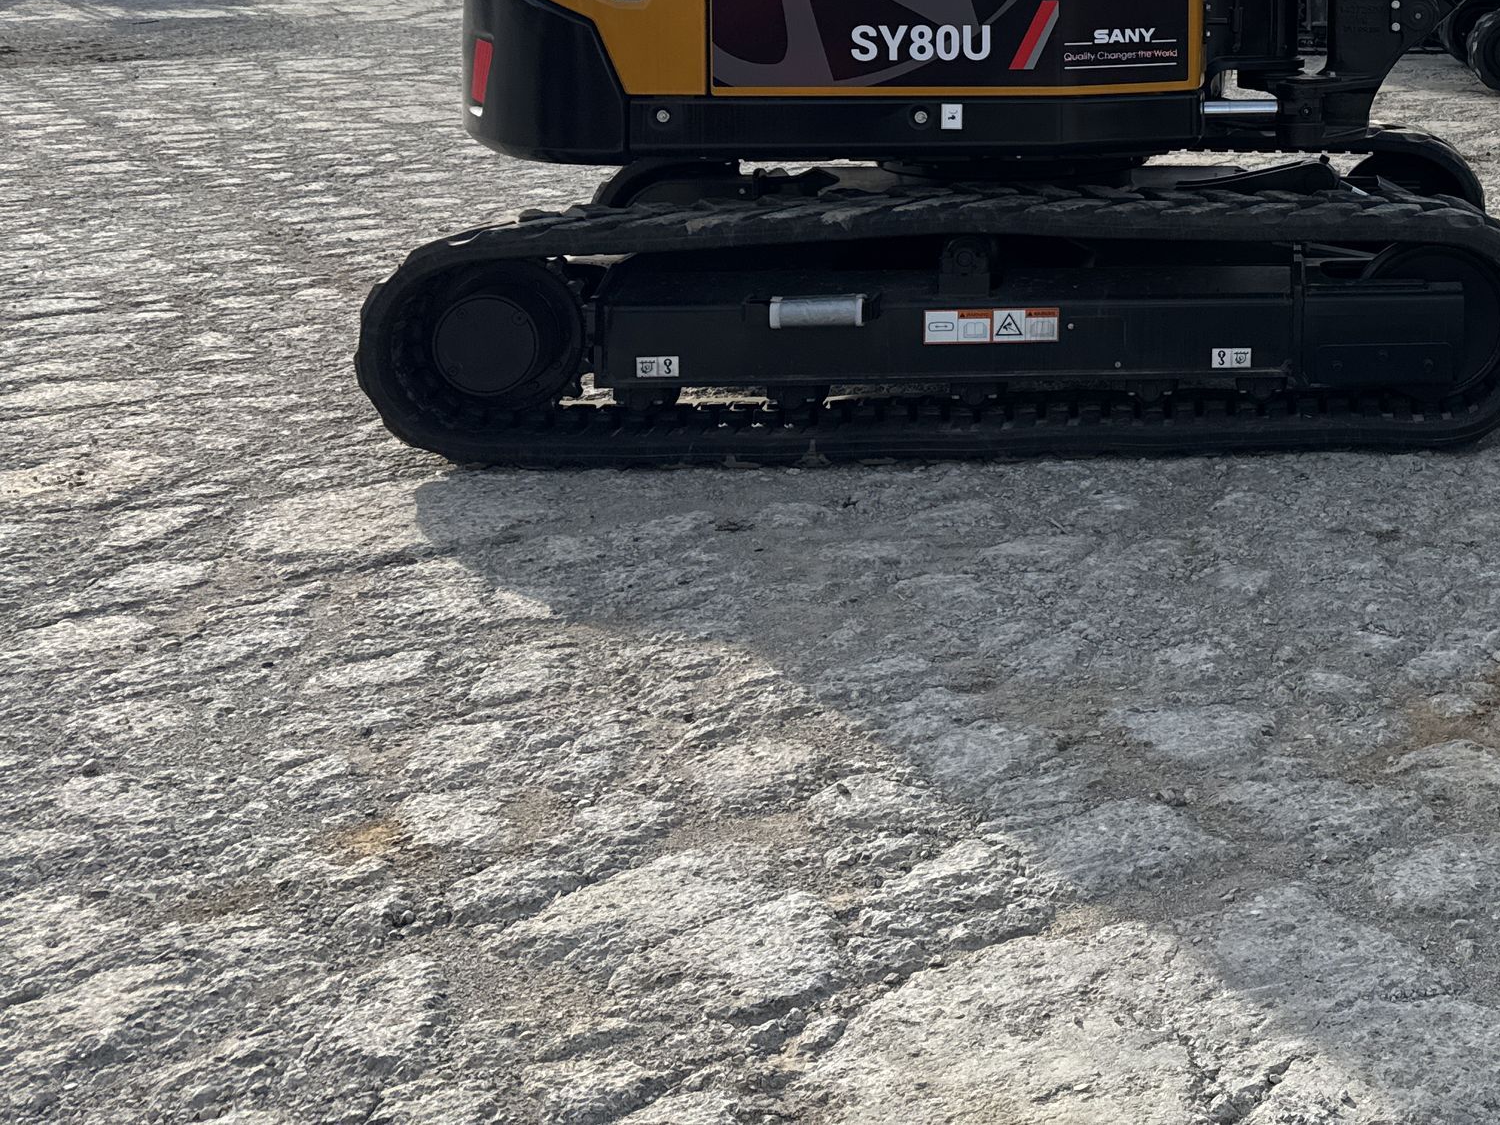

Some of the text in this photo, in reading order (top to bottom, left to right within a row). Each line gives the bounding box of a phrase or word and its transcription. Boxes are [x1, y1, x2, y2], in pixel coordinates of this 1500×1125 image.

[850, 25, 991, 61] SY80U
[1093, 27, 1156, 44] SANY
[1064, 49, 1177, 62] Quality Changes the World
